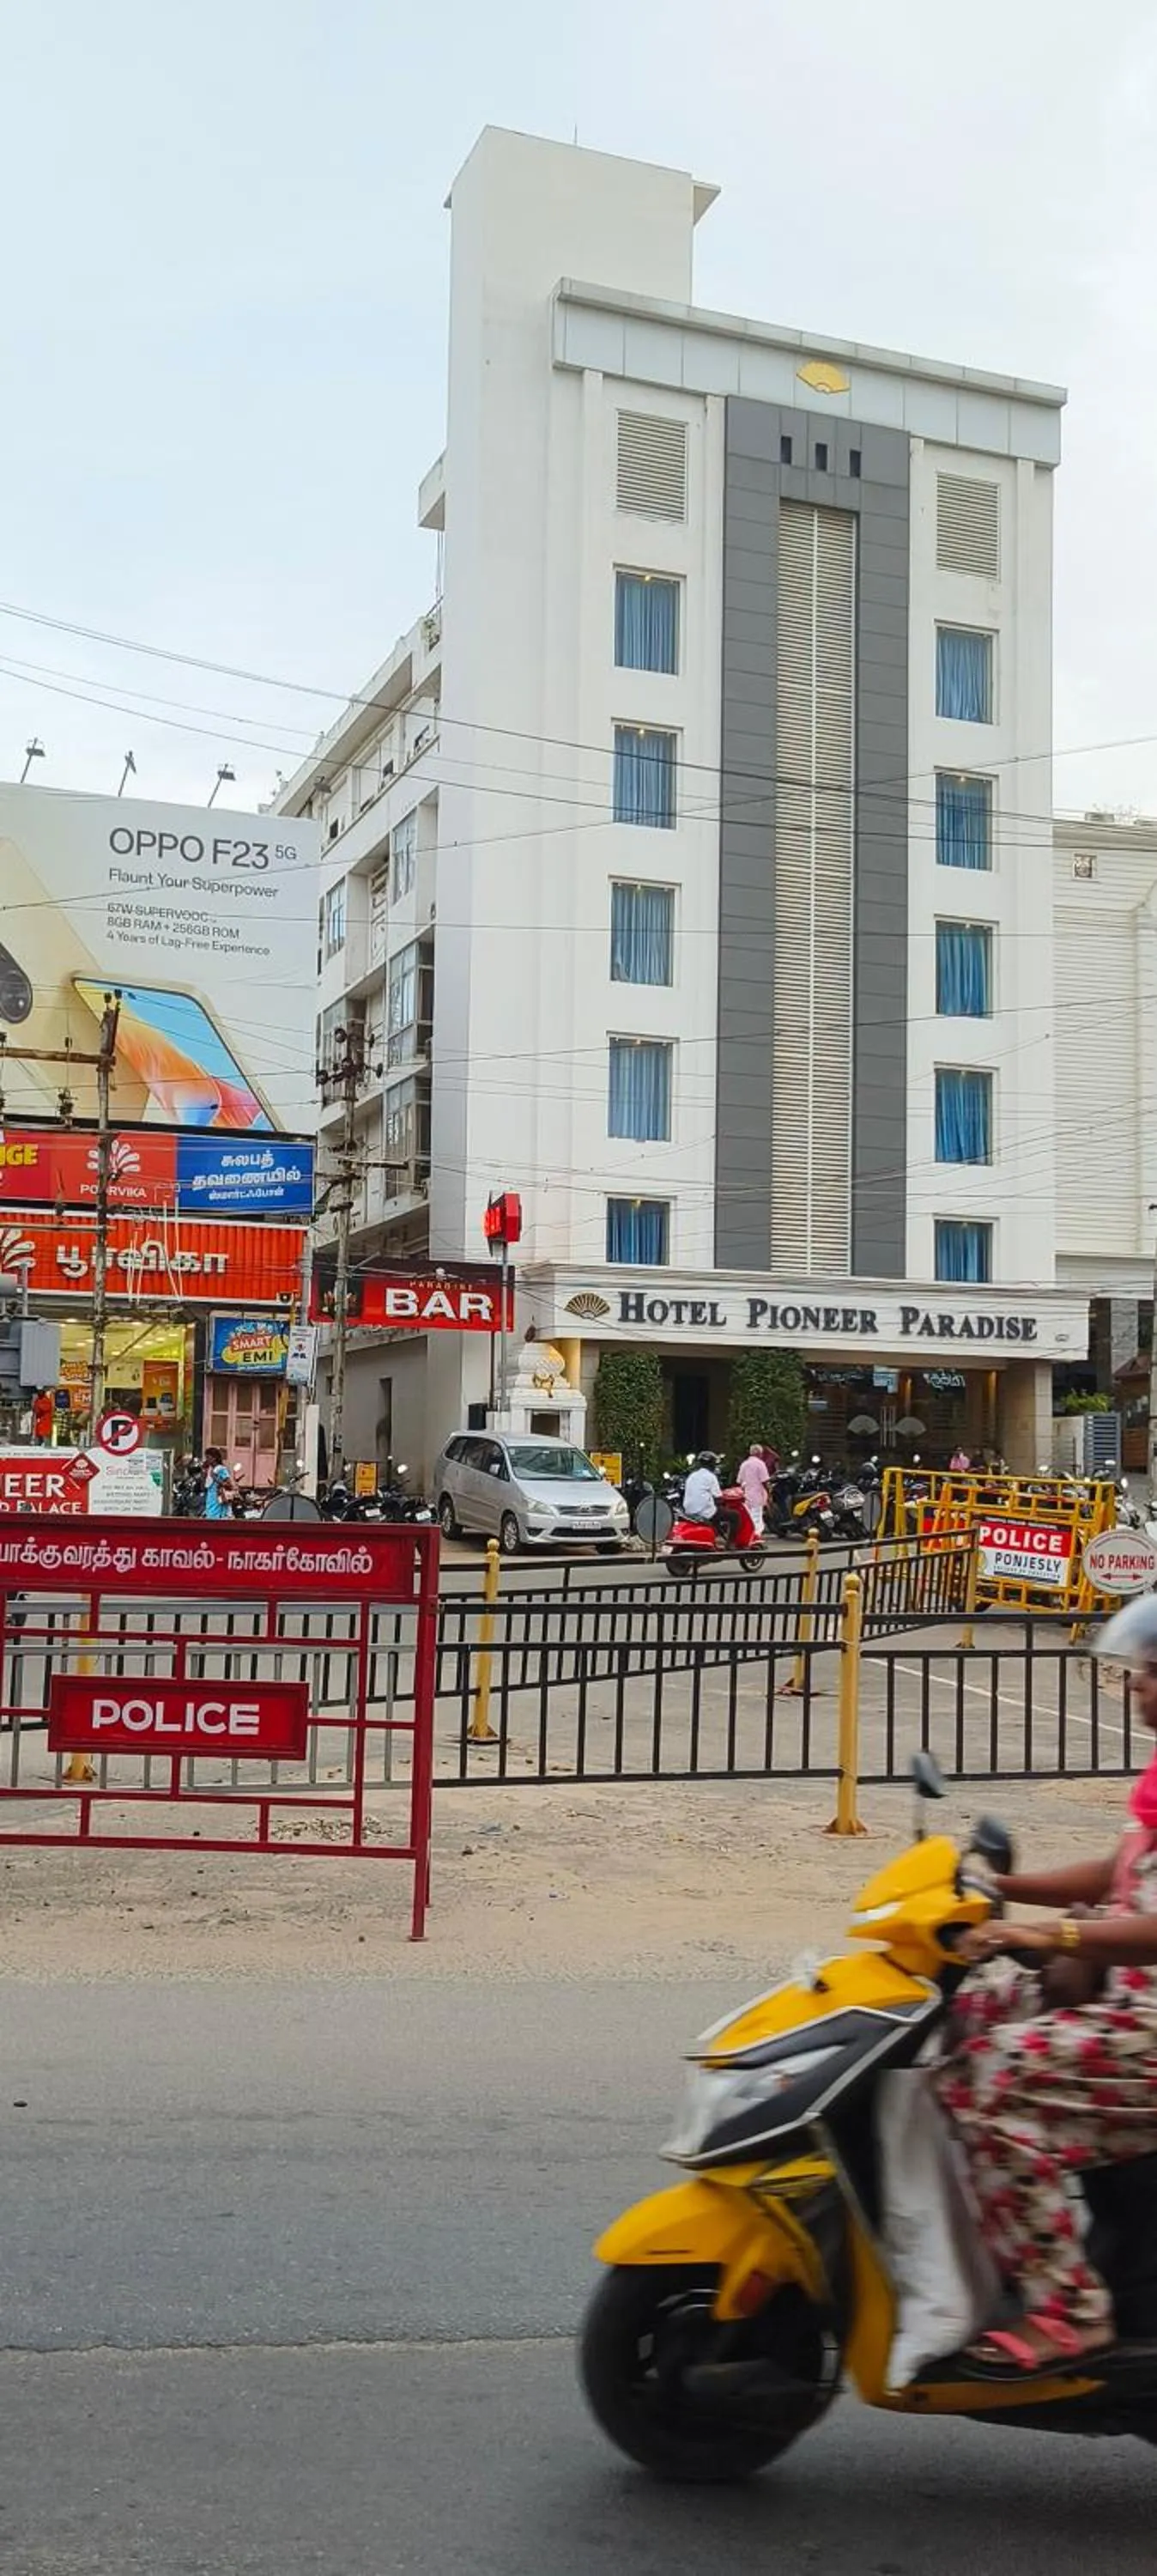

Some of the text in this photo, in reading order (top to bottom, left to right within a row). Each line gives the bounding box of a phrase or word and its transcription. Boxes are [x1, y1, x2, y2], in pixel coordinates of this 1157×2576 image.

[109, 827, 297, 870] OPPO F23 5G
[109, 868, 279, 897] Flaunt Your Superpower
[107, 902, 209, 923] 67W SUPERVOOC
[107, 916, 131, 928] 8GB
[133, 919, 161, 932] RAM
[173, 924, 210, 937] 256GB
[212, 927, 239, 939] ROM
[106, 931, 271, 956] 4 Years of Lag-Free Experience
[80, 1184, 147, 1198] PORVIKA
[385, 1287, 494, 1322] BAR
[617, 1291, 1038, 1342] HOTEL PIONEER PARADISE
[232, 1335, 272, 1351] SMART
[243, 1351, 273, 1363] EMI
[0, 1473, 66, 1498] EER
[978, 1526, 1063, 1552] POLICE
[227, 1544, 373, 1574] நாகர்கோவில்
[1089, 1554, 1154, 1570] NO PARKING
[92, 1699, 260, 1736] POLICE
